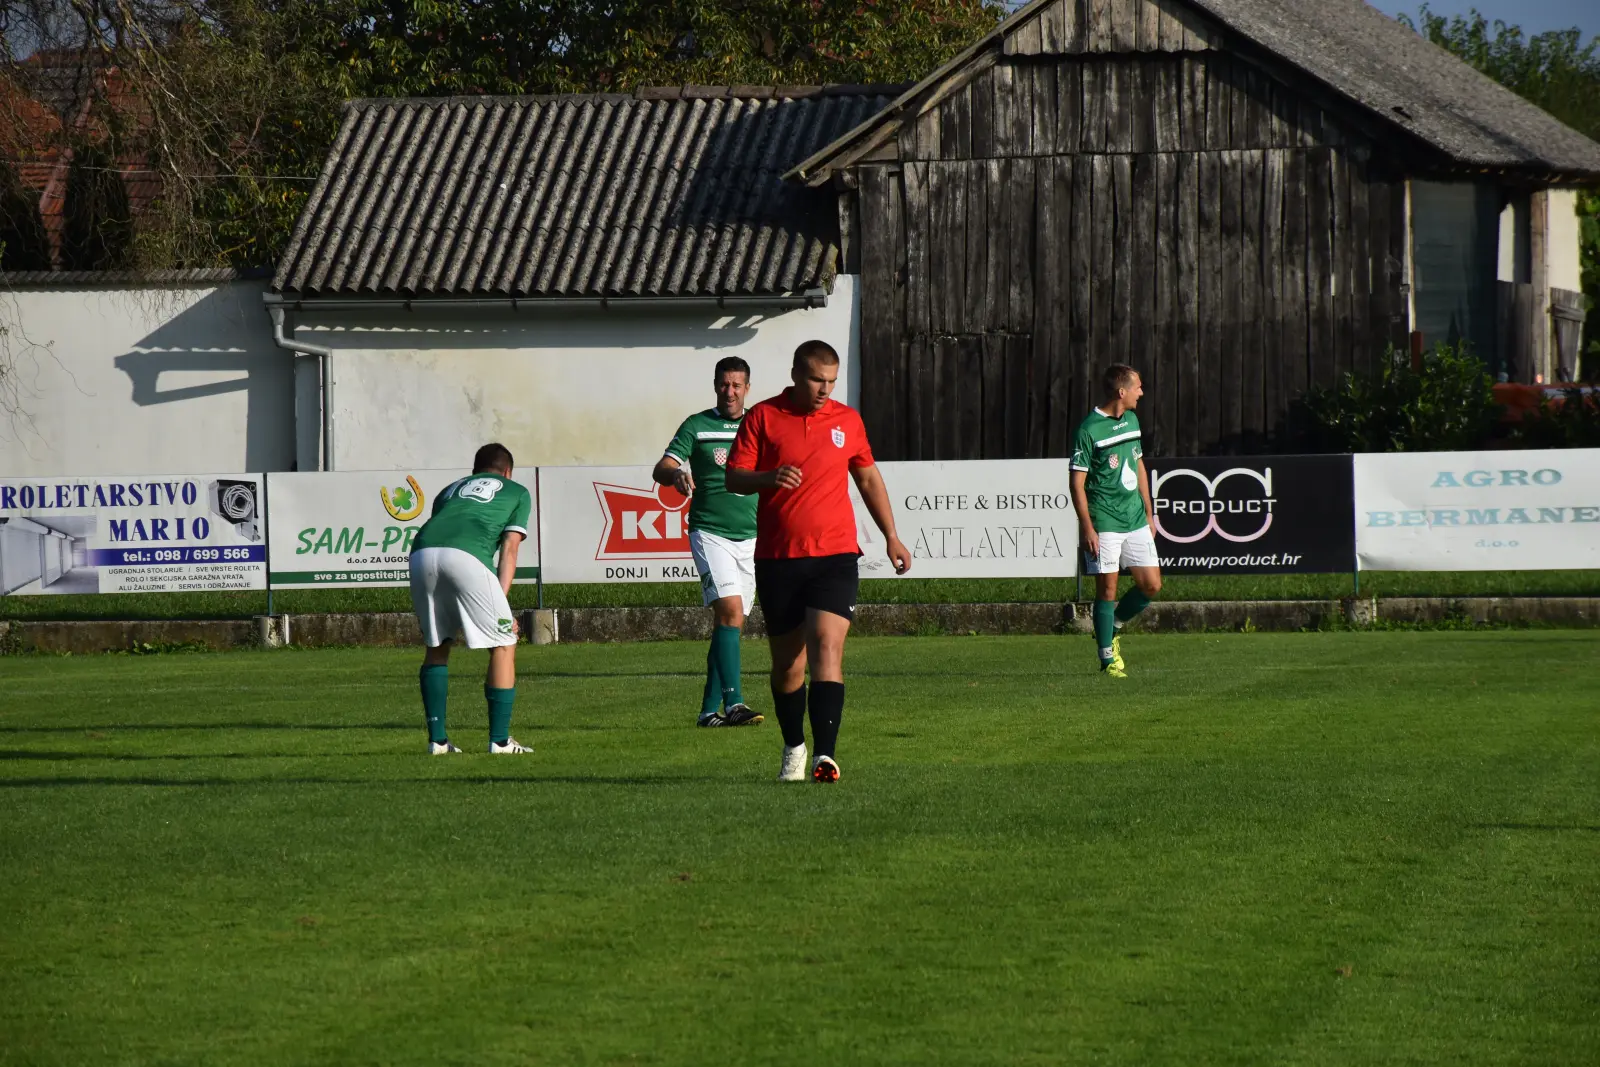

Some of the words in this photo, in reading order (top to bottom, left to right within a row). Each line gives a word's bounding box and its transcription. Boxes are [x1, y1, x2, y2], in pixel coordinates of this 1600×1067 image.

[1430, 469, 1562, 488] AGRO
[1, 481, 197, 509] ROLETARSTVO
[904, 494, 968, 510] CAFFE
[974, 494, 989, 509] &
[995, 494, 1069, 510] BISTRO
[1365, 506, 1600, 527] BERMANE
[108, 517, 210, 542] MARIO
[913, 526, 1064, 559] ATLANTA
[123, 551, 151, 562] tel.:
[155, 550, 181, 561] 098
[185, 550, 189, 561] /
[193, 549, 219, 560] 699
[223, 548, 249, 559] 566
[1157, 553, 1301, 569] w.mwproduct.hr
[188, 573, 220, 581] GARAŽNA
[605, 567, 648, 579] DONJI
[662, 566, 698, 578] KRAL
